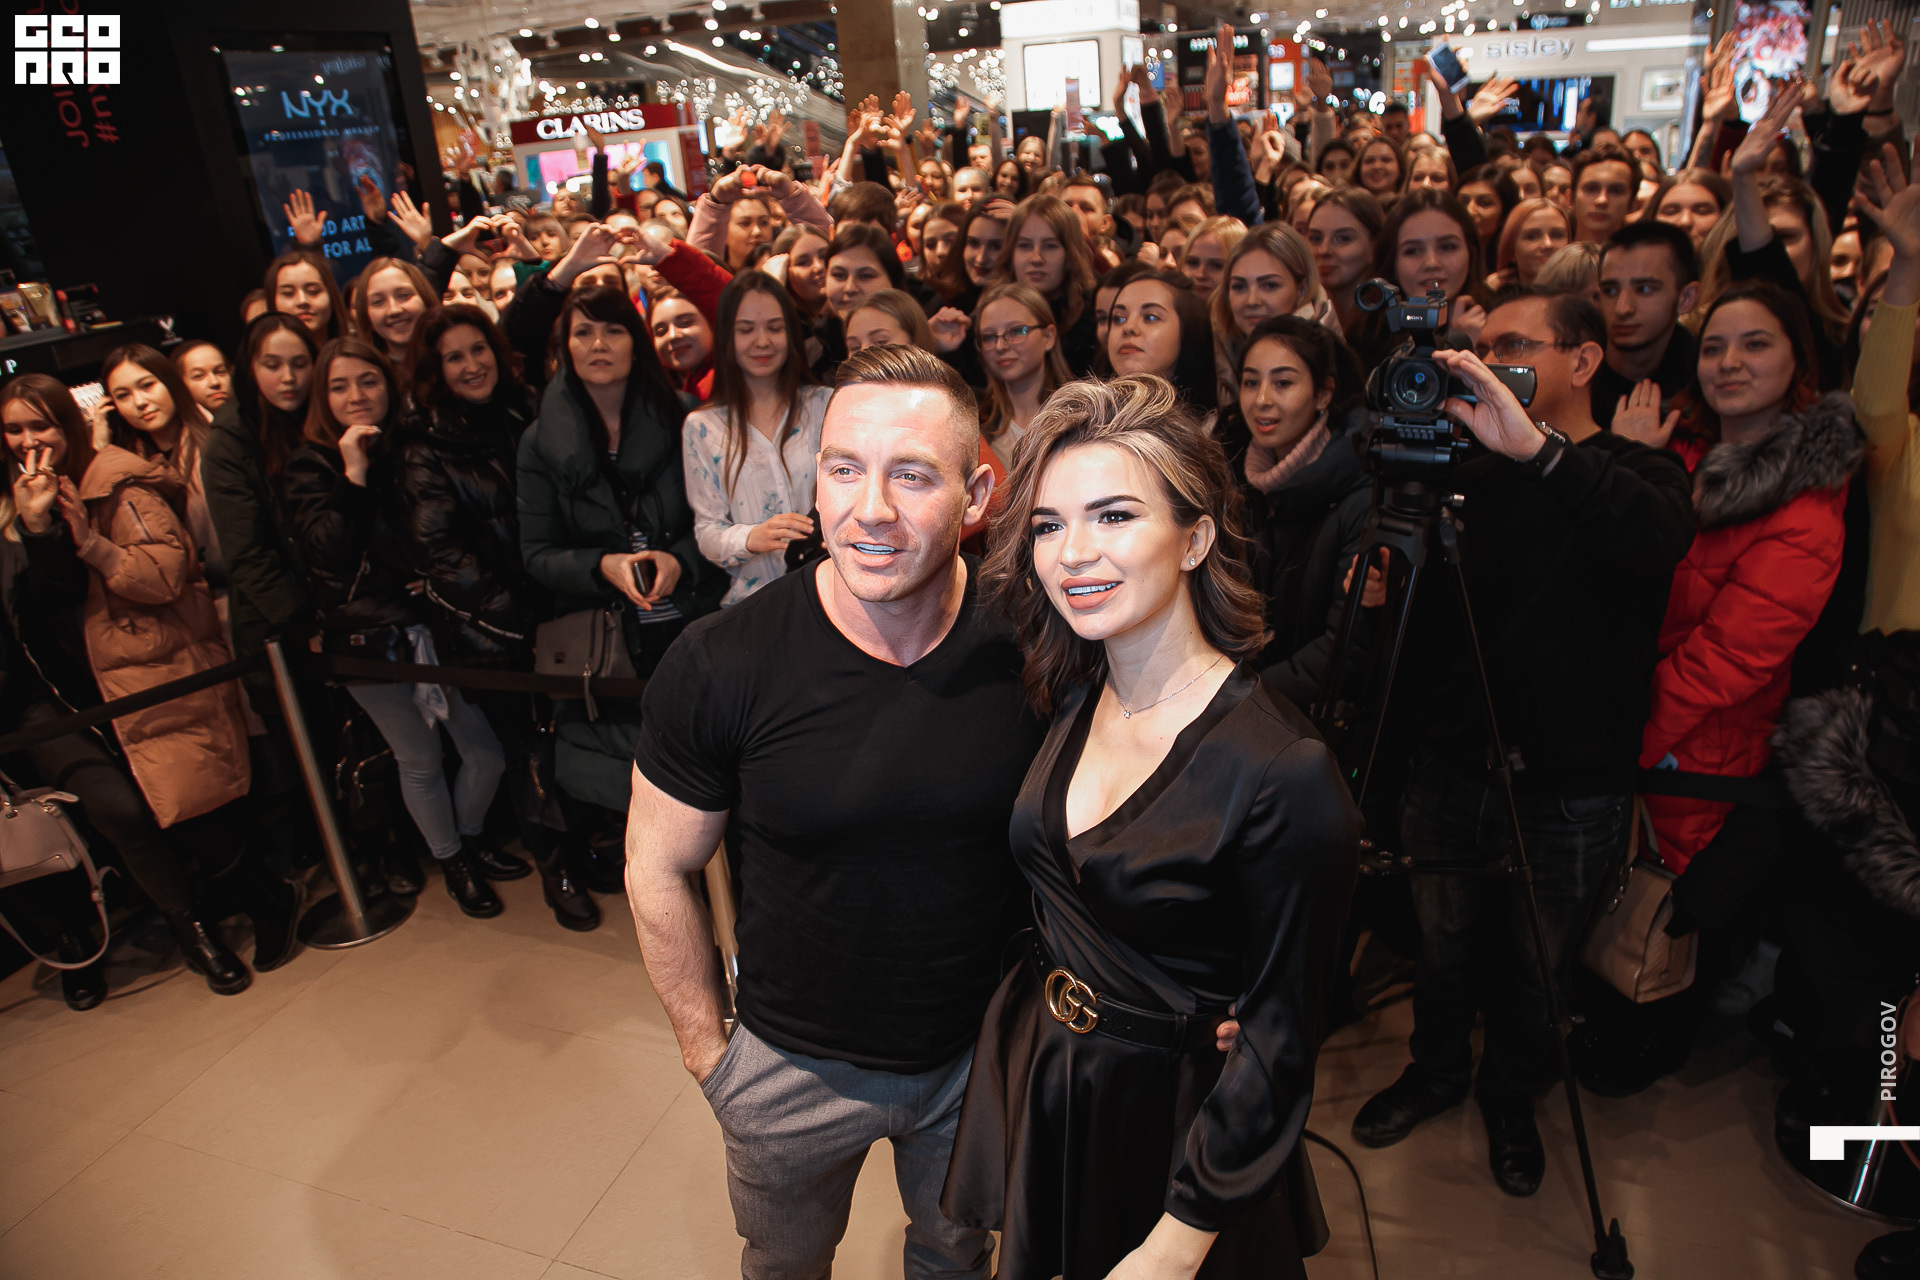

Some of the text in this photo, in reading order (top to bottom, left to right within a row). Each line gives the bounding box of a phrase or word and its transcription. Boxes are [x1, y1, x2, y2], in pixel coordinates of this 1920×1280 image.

[1486, 36, 1575, 60] sisley
[281, 88, 353, 119] NYX
[536, 108, 645, 139] CLARINS
[323, 241, 352, 259] FOR
